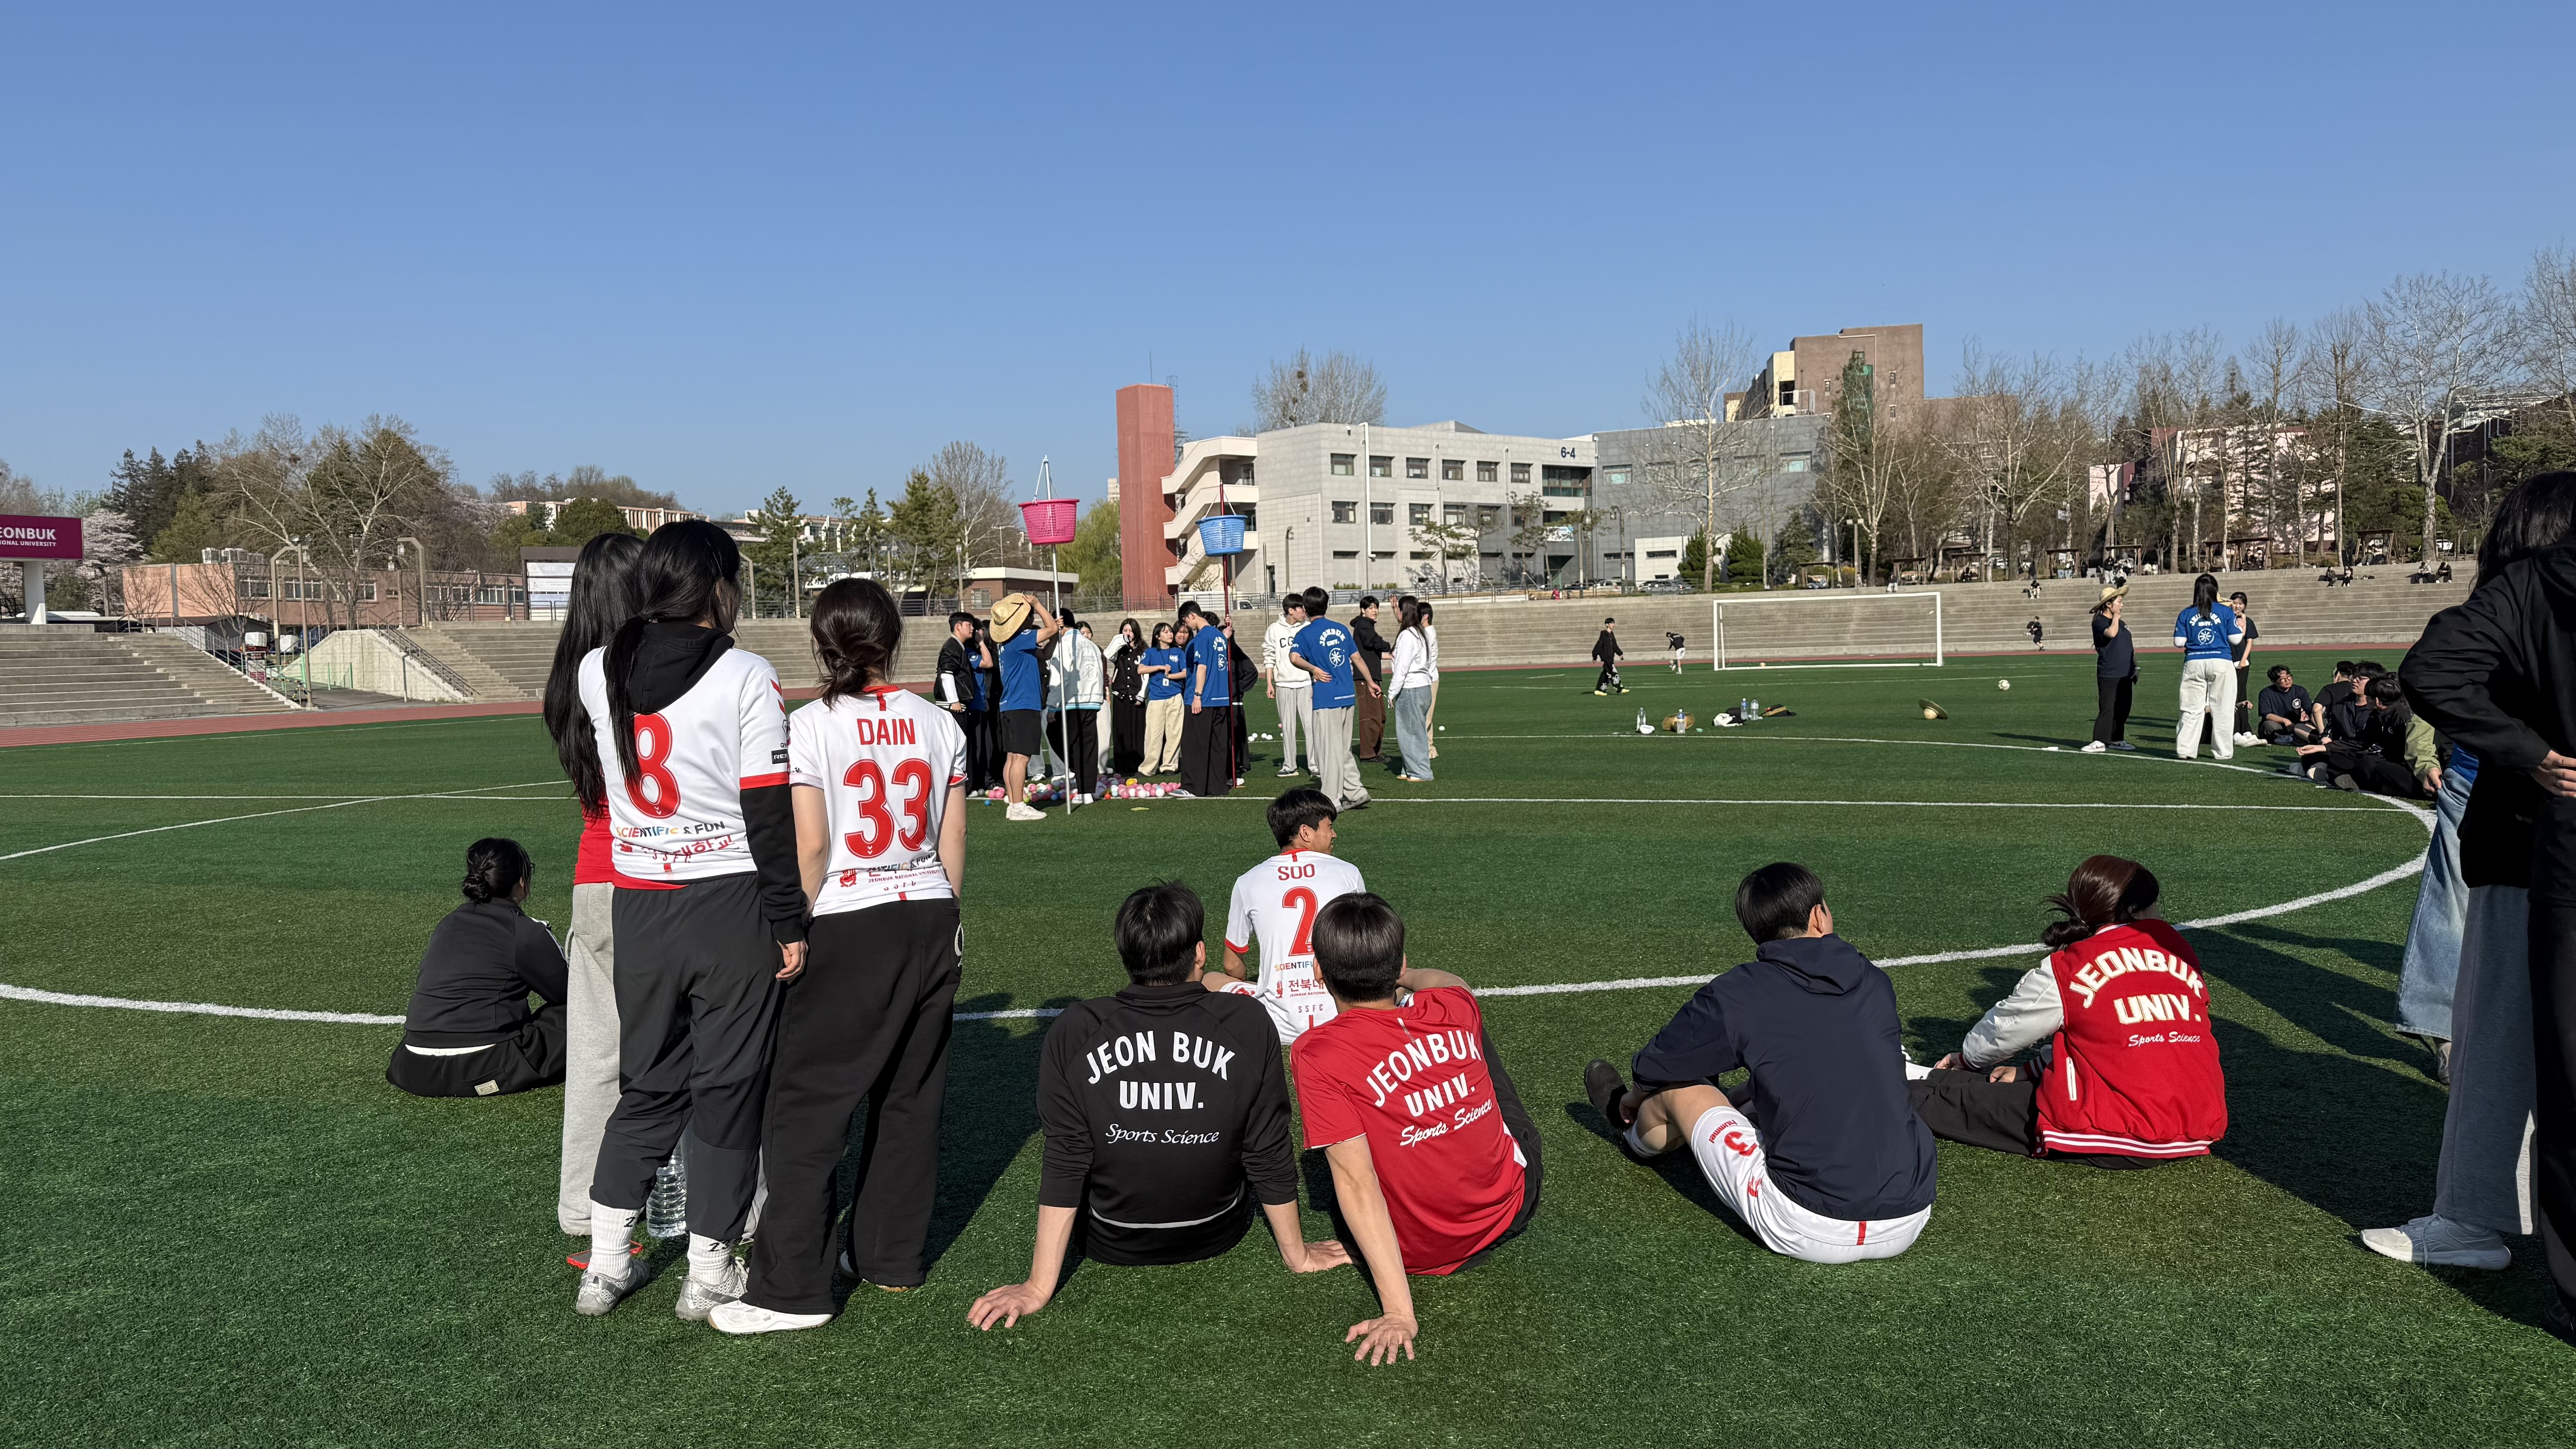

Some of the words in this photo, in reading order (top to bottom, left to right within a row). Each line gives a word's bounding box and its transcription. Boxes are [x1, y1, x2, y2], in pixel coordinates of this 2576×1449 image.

[1561, 446, 1575, 459] 6-4
[857, 718, 916, 745] DAIN
[624, 712, 681, 819] 8
[843, 758, 933, 859] 33
[616, 826, 678, 837] SCIENTIFIC
[1282, 886, 1318, 957] 2
[1274, 961, 1313, 971] SCIENTIFI
[2069, 947, 2203, 1009] JEONBUK
[2113, 994, 2202, 1025] UNIV.
[2128, 1033, 2165, 1047] Sports
[2168, 1031, 2201, 1043] Science
[1086, 1030, 1156, 1084] JEON
[1172, 1031, 1235, 1081] BUK
[1366, 1030, 1482, 1108] JEONBUK
[1119, 1081, 1204, 1110] UNIV.
[1404, 1072, 1476, 1117] UNIV.
[1105, 1123, 1158, 1144] Sports
[1160, 1129, 1220, 1145] Science
[1399, 1122, 1449, 1147] Sports
[1454, 1098, 1493, 1130] Science
[1708, 1119, 1738, 1144] hummel
